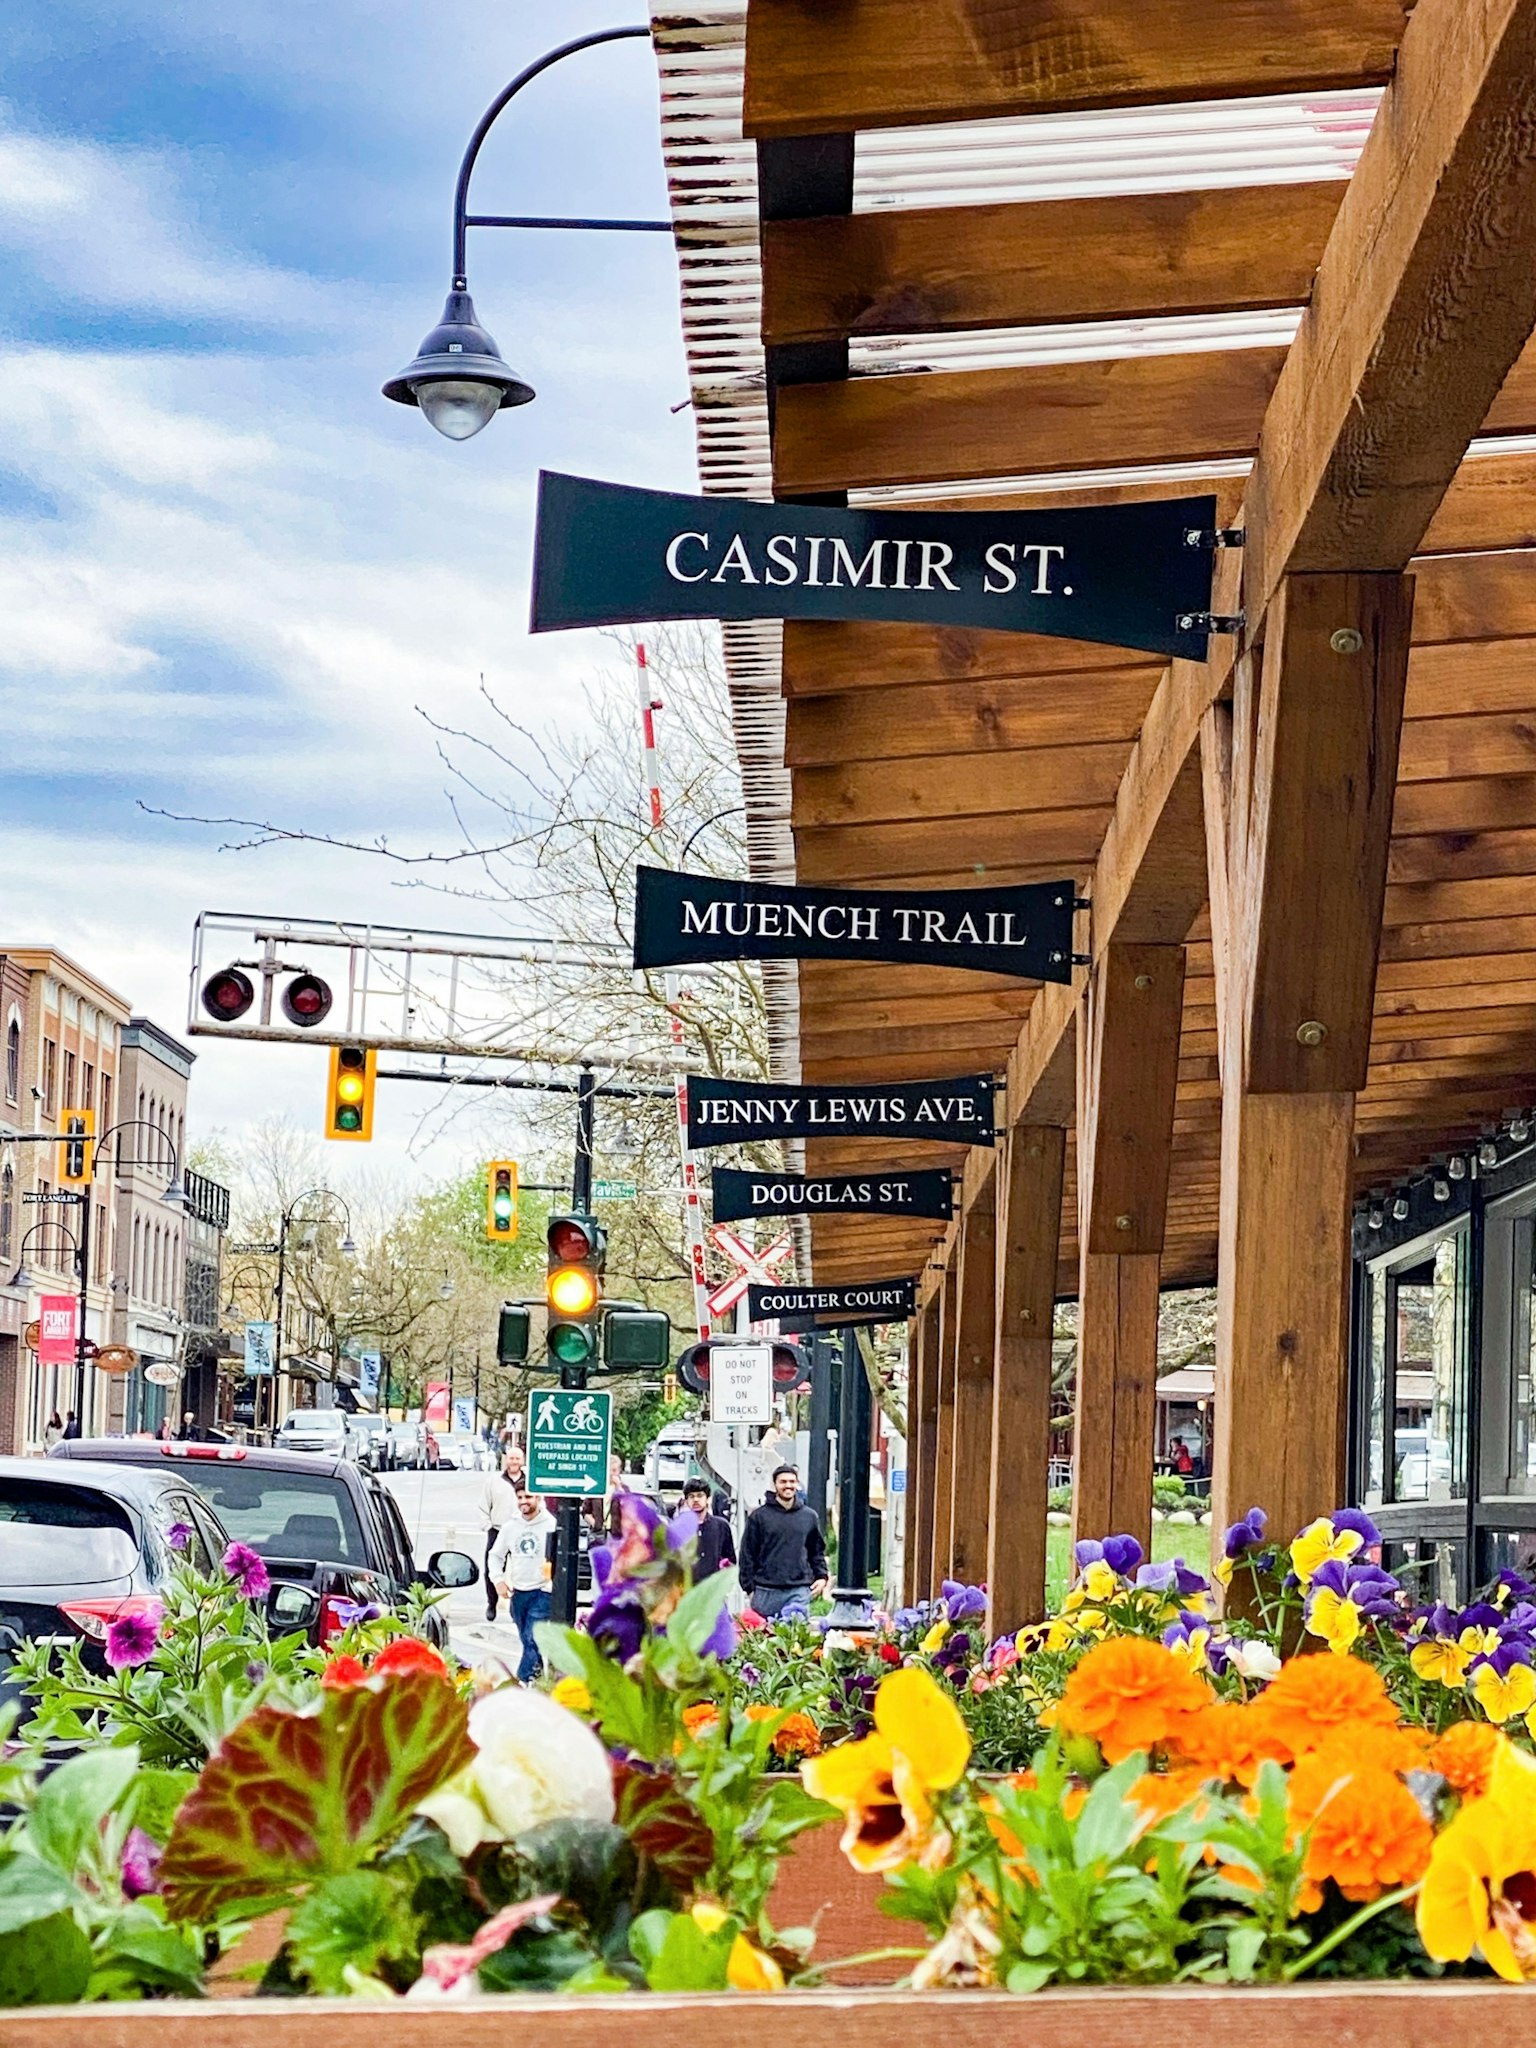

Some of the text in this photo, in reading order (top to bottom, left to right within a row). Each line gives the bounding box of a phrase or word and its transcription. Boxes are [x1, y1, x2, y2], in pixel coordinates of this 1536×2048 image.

[665, 531, 1074, 596] CASIMIR ST.
[681, 900, 1027, 946] MUENCH TRAIL
[696, 1098, 983, 1125] JENNY LEWIS AVE.
[751, 1183, 913, 1205] DOUGLAS ST.
[759, 1290, 904, 1311] COULTER COURT
[43, 1310, 72, 1327] FORT
[725, 1359, 757, 1369] DO NOT
[730, 1375, 753, 1385] STOP
[735, 1390, 748, 1400] ON
[725, 1405, 759, 1415] TRACKS
[533, 1442, 572, 1451] PEDESTRIAN
[573, 1443, 587, 1451] AND
[537, 1452, 599, 1462] OVERPASS LOCATED
